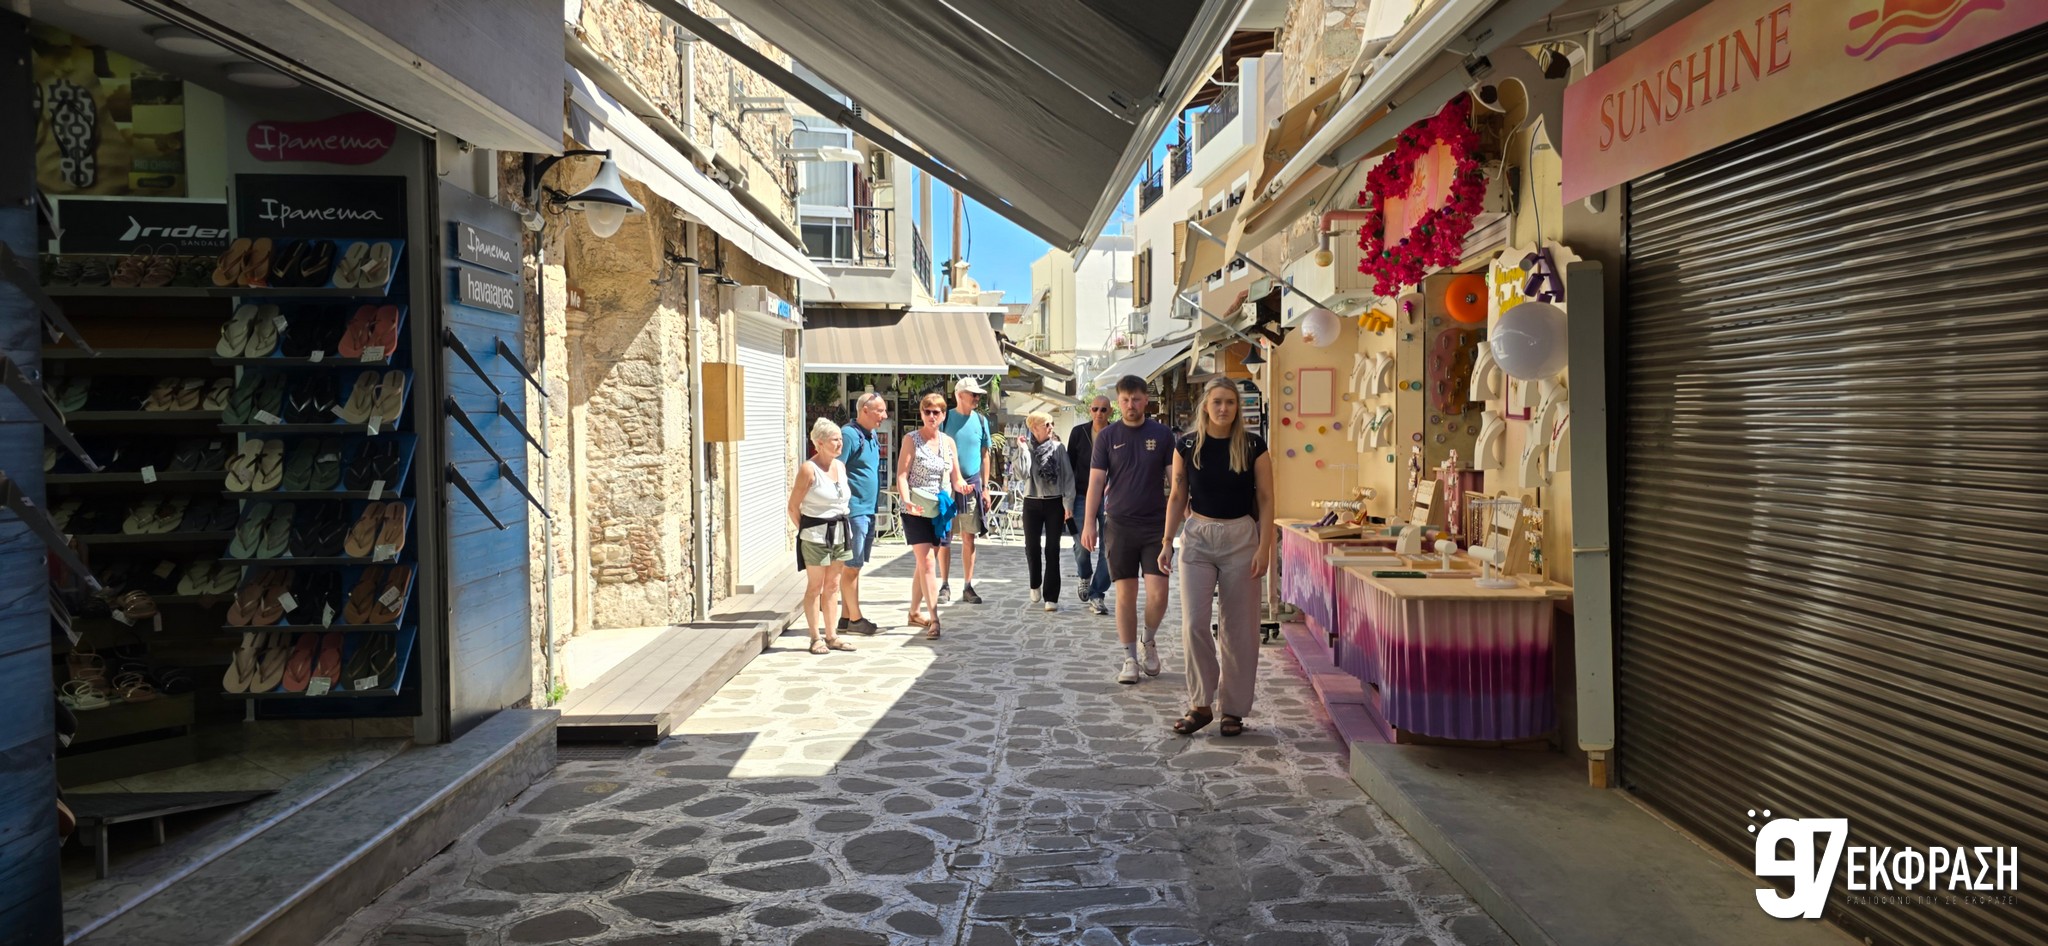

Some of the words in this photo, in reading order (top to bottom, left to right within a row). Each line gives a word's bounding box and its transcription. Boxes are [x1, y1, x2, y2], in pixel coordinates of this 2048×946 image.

[1599, 3, 1792, 151] SUNSHINE
[255, 125, 389, 160] Ipanema
[259, 198, 383, 228] Ipanema
[141, 225, 229, 238] rider
[467, 227, 512, 263] Ipanema
[467, 273, 514, 309] havaianas
